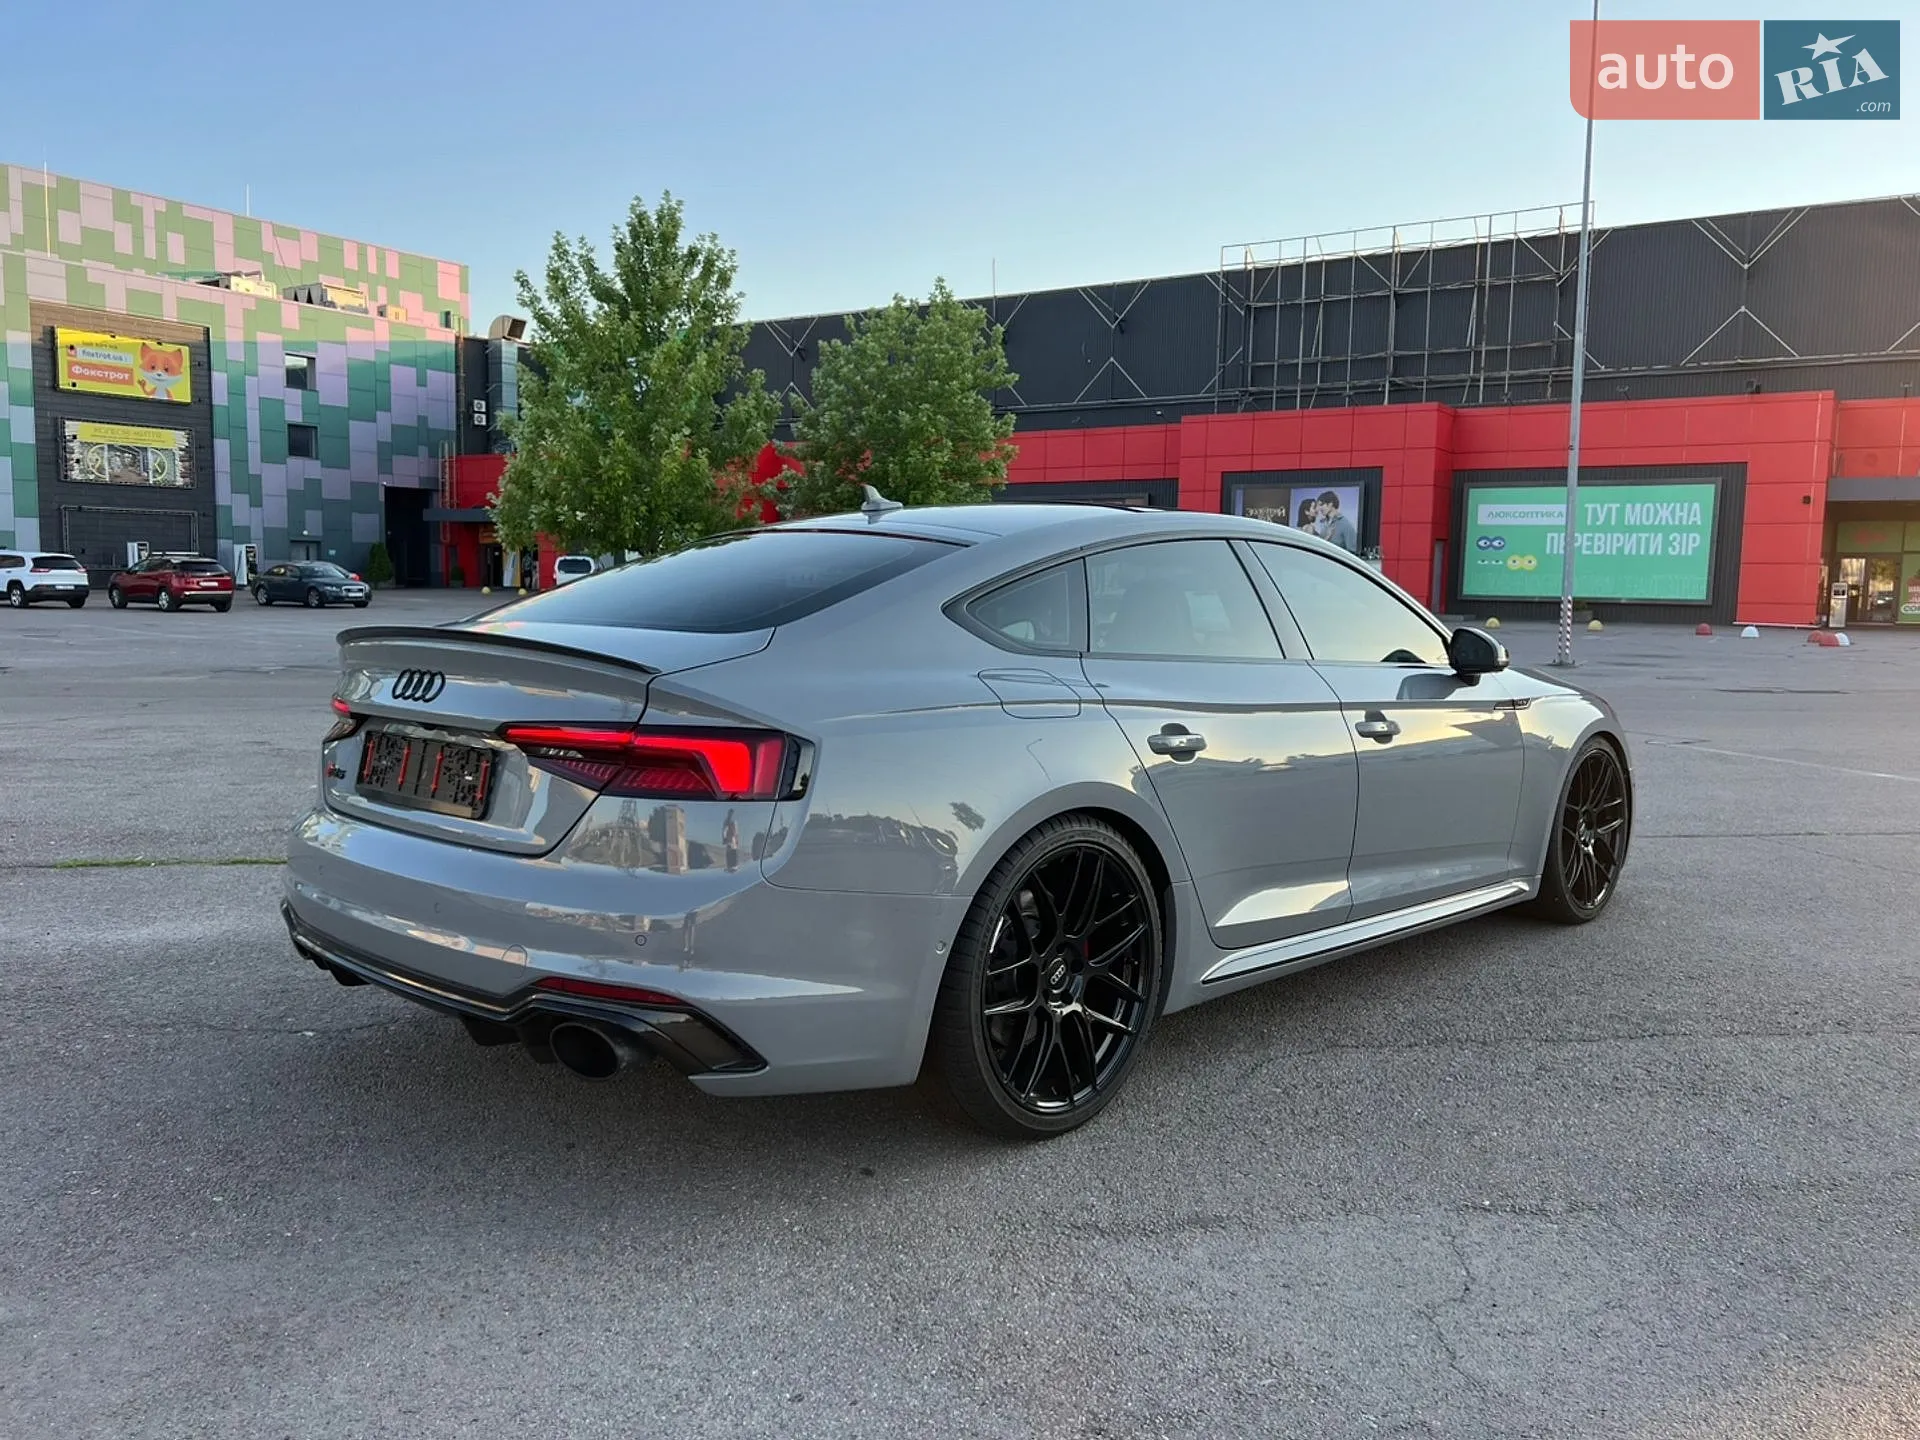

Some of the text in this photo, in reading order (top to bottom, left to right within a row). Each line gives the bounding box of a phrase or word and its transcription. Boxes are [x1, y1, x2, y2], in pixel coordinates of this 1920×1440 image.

[71, 364, 130, 381] Фокстрот
[1487, 510, 1564, 519] ЛЮКСОПТИКА
[1584, 502, 1702, 526] ТУТ МОЖНА
[1668, 532, 1701, 556] ЗІР
